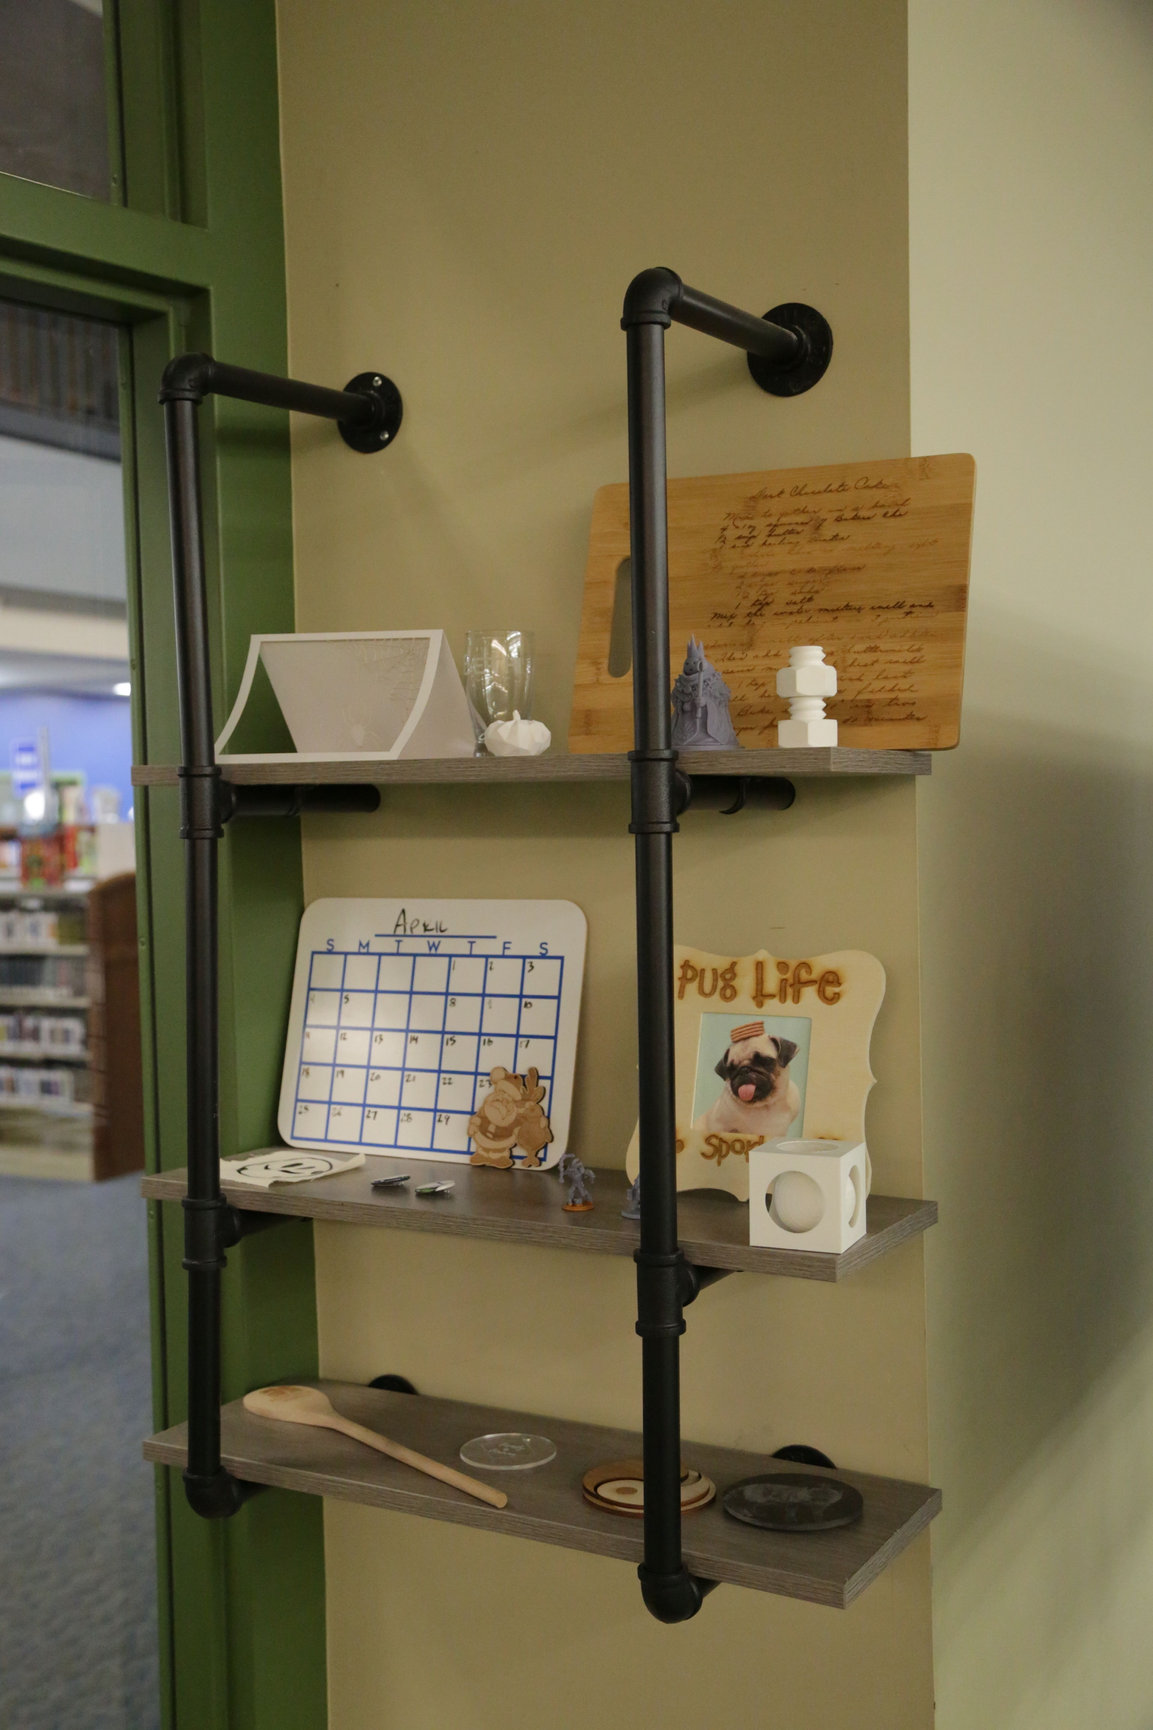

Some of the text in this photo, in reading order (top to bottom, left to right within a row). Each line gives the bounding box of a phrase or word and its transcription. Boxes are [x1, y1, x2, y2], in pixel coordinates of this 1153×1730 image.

[790, 481, 849, 497] Chocolate
[854, 477, 891, 490] Cake
[326, 938, 549, 956] S M T W T F S
[527, 960, 535, 973] 3
[752, 961, 842, 1009] Life
[449, 997, 457, 1007] 8
[374, 1033, 384, 1045] 13
[409, 1034, 419, 1045] 14
[445, 1036, 456, 1046] 15
[482, 1037, 493, 1047] 16
[370, 1071, 382, 1082] 20
[405, 1073, 416, 1083] 21
[442, 1076, 453, 1086] 22
[478, 1079, 493, 1088] 23
[366, 1109, 378, 1121] 27
[436, 1114, 450, 1125] 29
